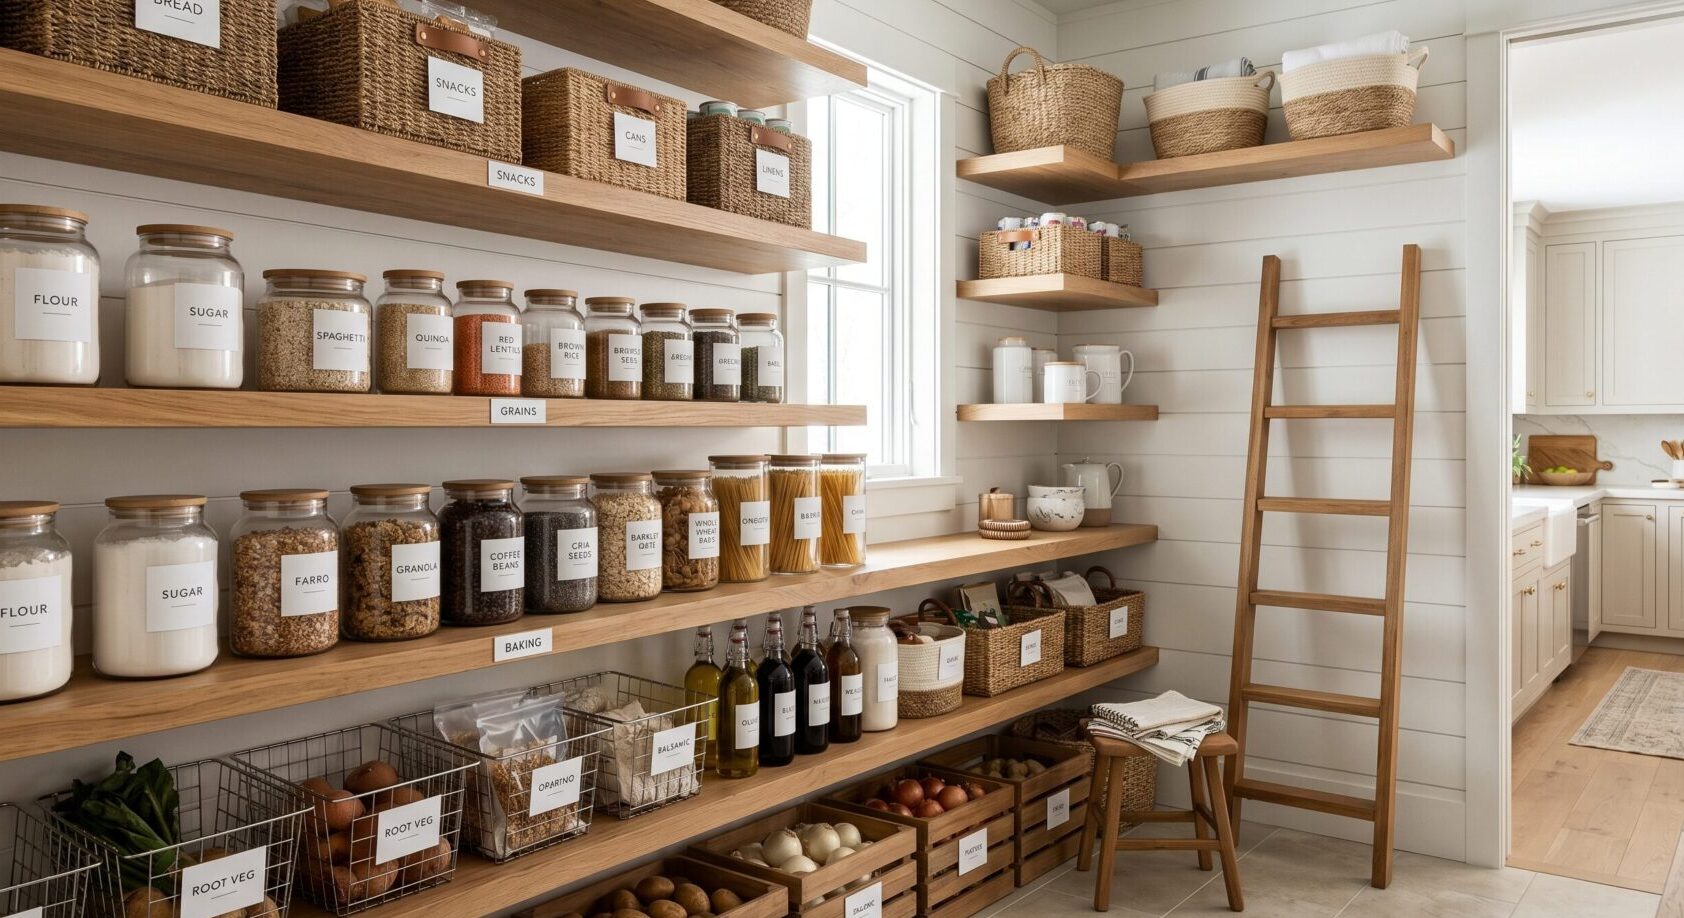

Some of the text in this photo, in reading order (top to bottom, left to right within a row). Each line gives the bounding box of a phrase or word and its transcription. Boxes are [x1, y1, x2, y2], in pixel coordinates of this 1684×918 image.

[436, 77, 476, 97] SNACKS
[625, 131, 647, 143] CANS
[497, 170, 536, 187] SNACKS
[34, 294, 78, 307] FLOUR
[189, 306, 229, 319] SUGAR
[415, 333, 450, 343] QUINOA
[498, 336, 515, 344] RED
[564, 352, 580, 360] RICE
[500, 406, 537, 416] GRAINS
[490, 550, 521, 561] COFFEE
[568, 550, 592, 560] SEEDS
[396, 562, 438, 575] GRANOLA
[492, 561, 519, 571] BEANS
[295, 574, 330, 586] FARRO
[162, 586, 203, 600] SUGAR
[0, 604, 48, 618] FLOUR
[505, 637, 542, 653] BAKING
[385, 815, 434, 838] ROOT VEG
[192, 869, 255, 897] ROOT VEG
